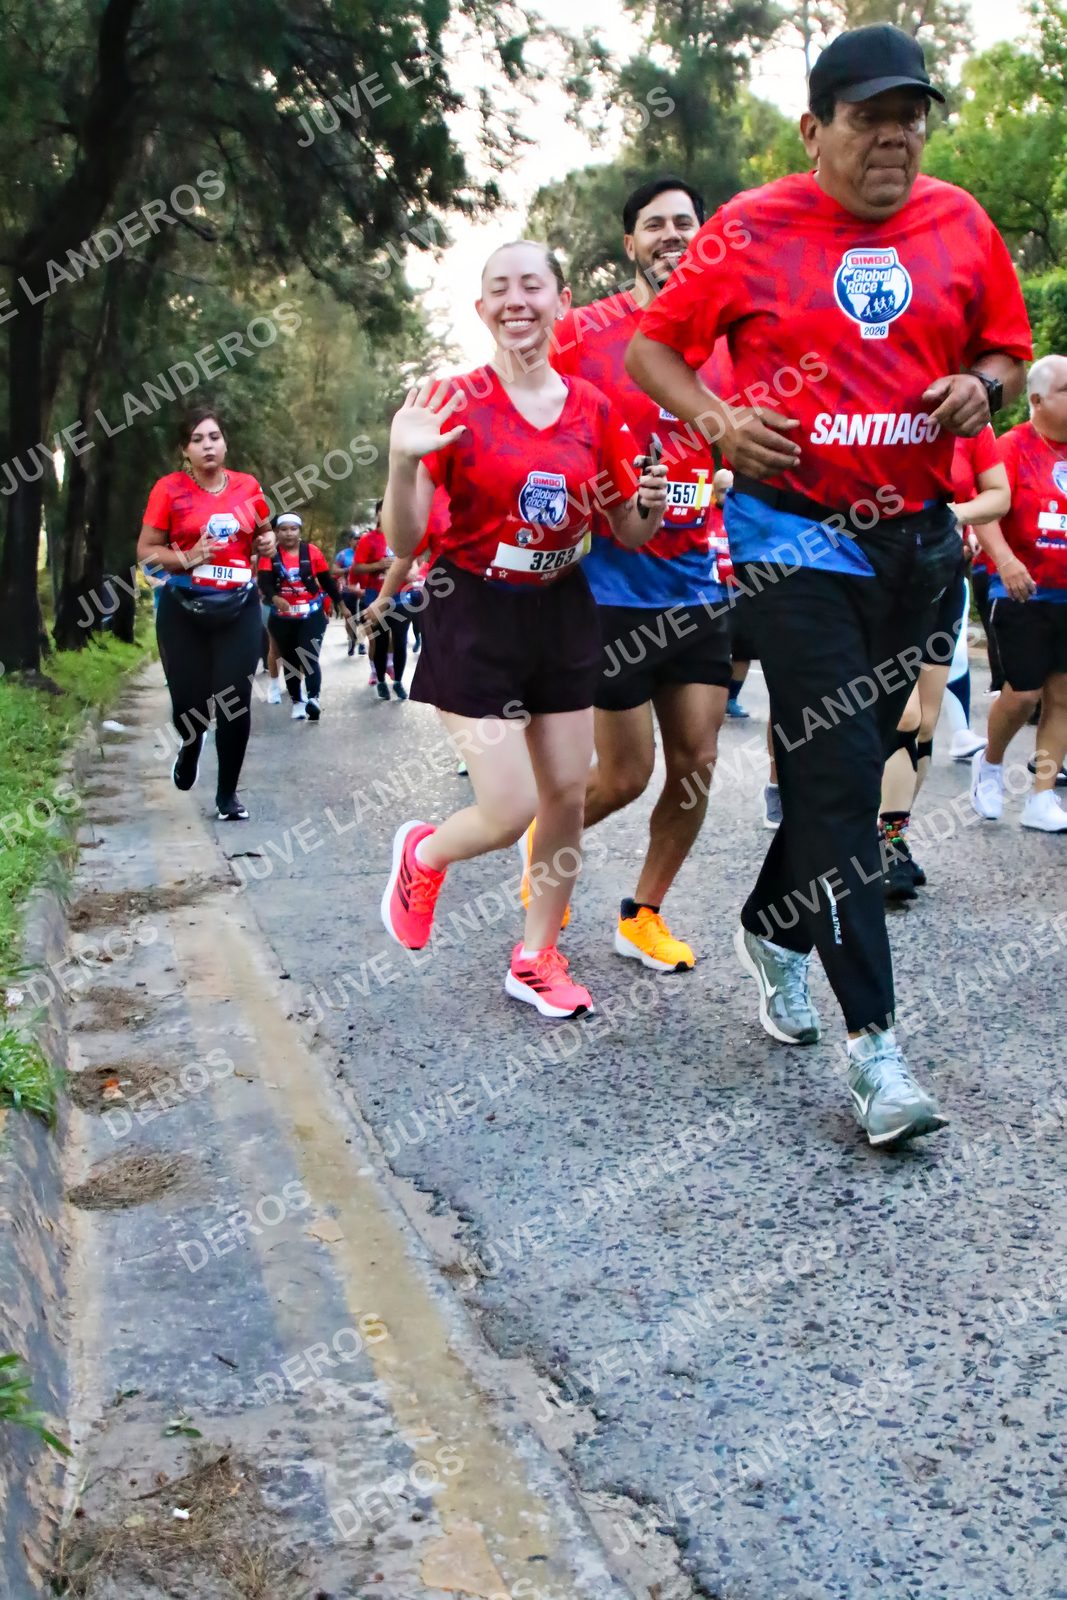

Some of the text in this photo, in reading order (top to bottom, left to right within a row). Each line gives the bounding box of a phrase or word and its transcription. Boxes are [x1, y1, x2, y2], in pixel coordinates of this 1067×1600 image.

[851, 256, 891, 265] BIMBO
[853, 269, 892, 282] Global
[846, 281, 878, 294] Race
[864, 326, 886, 336] 2026
[810, 412, 940, 446] SANTIAGO
[533, 477, 561, 487] BIMBO
[532, 488, 559, 500] Global
[526, 497, 547, 508] Race
[529, 547, 576, 571] 3263
[213, 567, 233, 579] 1914
